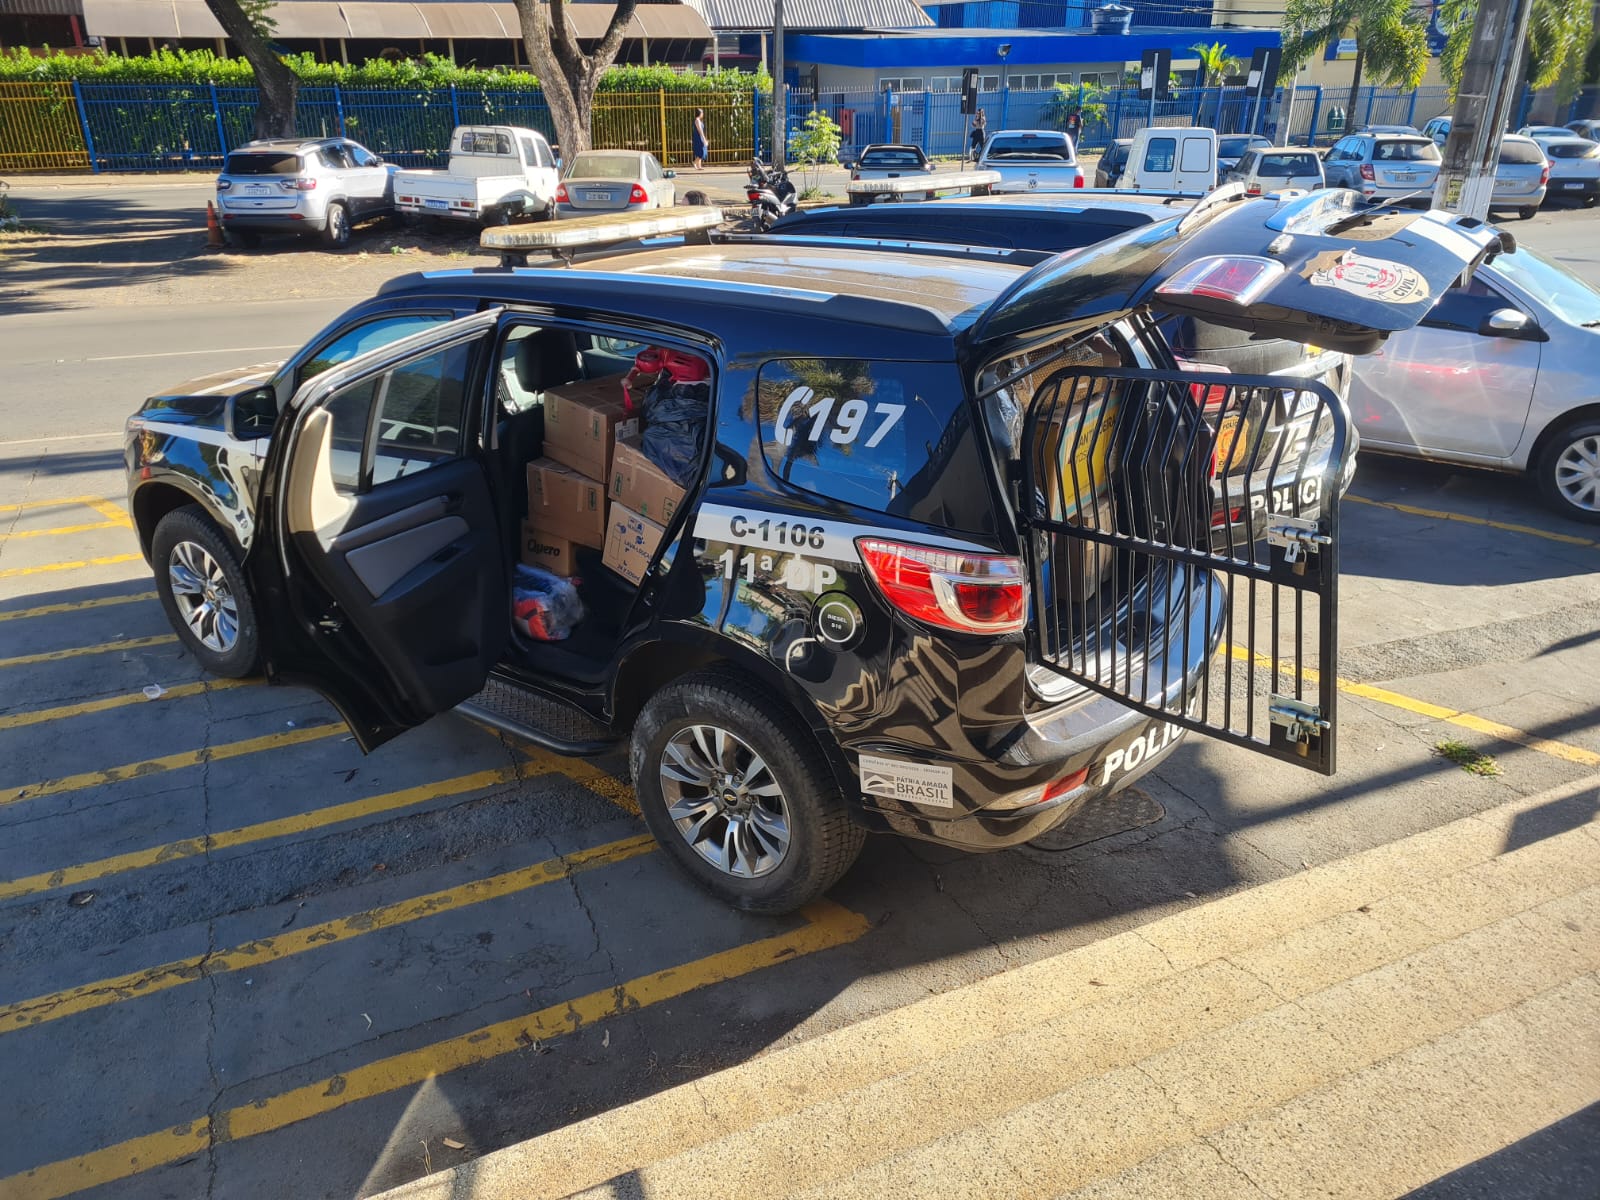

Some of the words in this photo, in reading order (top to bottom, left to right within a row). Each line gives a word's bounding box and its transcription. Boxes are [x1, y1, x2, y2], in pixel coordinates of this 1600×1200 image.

[1394, 277, 1415, 297] CIVIL
[807, 397, 906, 447] 197
[730, 514, 825, 550] C-1106
[527, 538, 560, 557] Quero
[827, 614, 848, 624] DIESEL
[896, 776, 920, 785] PÁTRIA
[921, 780, 948, 789] AMADA
[896, 783, 949, 800] BRASIL
